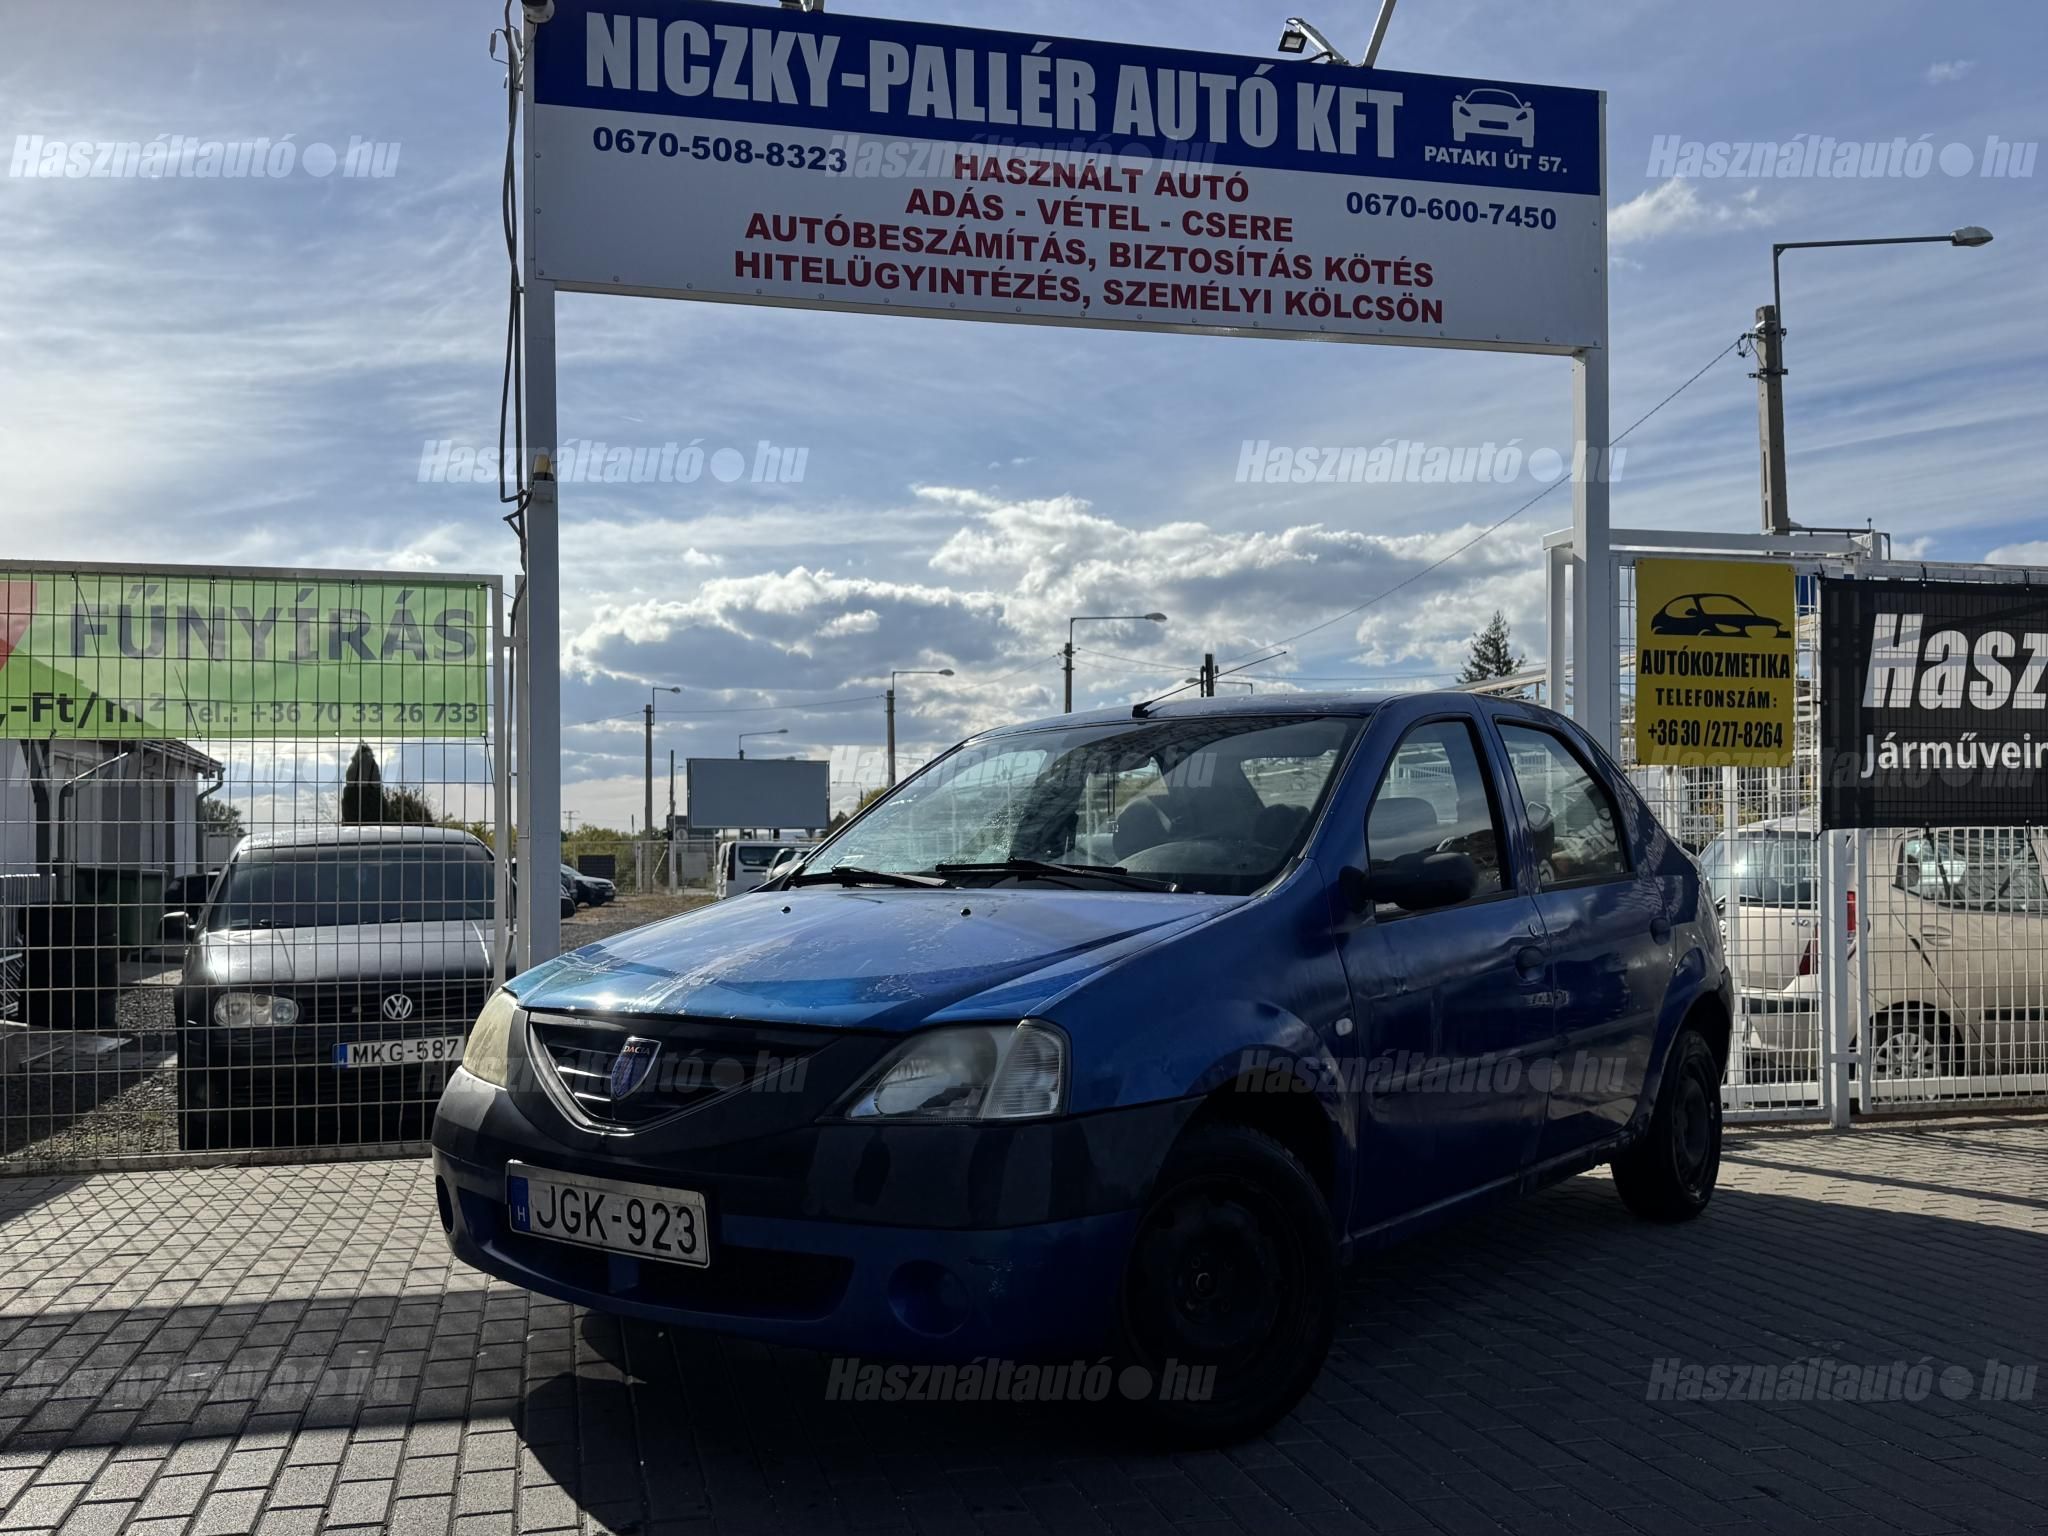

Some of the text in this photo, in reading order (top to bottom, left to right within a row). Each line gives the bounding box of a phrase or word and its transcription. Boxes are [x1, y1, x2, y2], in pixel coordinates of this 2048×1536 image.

[586, 11, 1403, 159] NICZKY-PALLÉR AUTÓ KFT
[593, 126, 847, 173] 0670-508-8323
[1424, 146, 1568, 174] PATAKI ÚT 57.
[954, 154, 1249, 202] HASZNÁLT AUTÓ
[905, 185, 1004, 221] ADÁS
[1038, 194, 1150, 232] VÉTEL
[1181, 210, 1294, 244] CSERE
[1346, 191, 1557, 230] 0670-600-7450
[745, 212, 1434, 288] AUTÓBESZÁMÍTÁS, BIZTOSÍTÁS KÖTÉS
[735, 250, 1443, 325] HITELÜGYINTÉZÉS, SZEMÉLYI KÖLCSÖN
[70, 585, 477, 662] FŰNYÍRÁS
[1640, 645, 1791, 679] AUTÓKOZMETIKA
[1862, 613, 2048, 711] Hasz
[182, 702, 238, 724] Tel.:
[251, 702, 302, 724] +36
[312, 703, 341, 724] 70
[352, 703, 383, 724] 33
[393, 703, 424, 724] 26
[432, 703, 479, 724] 733
[352, 1038, 459, 1063] MKG-587
[517, 1185, 697, 1255] H JGK-923
